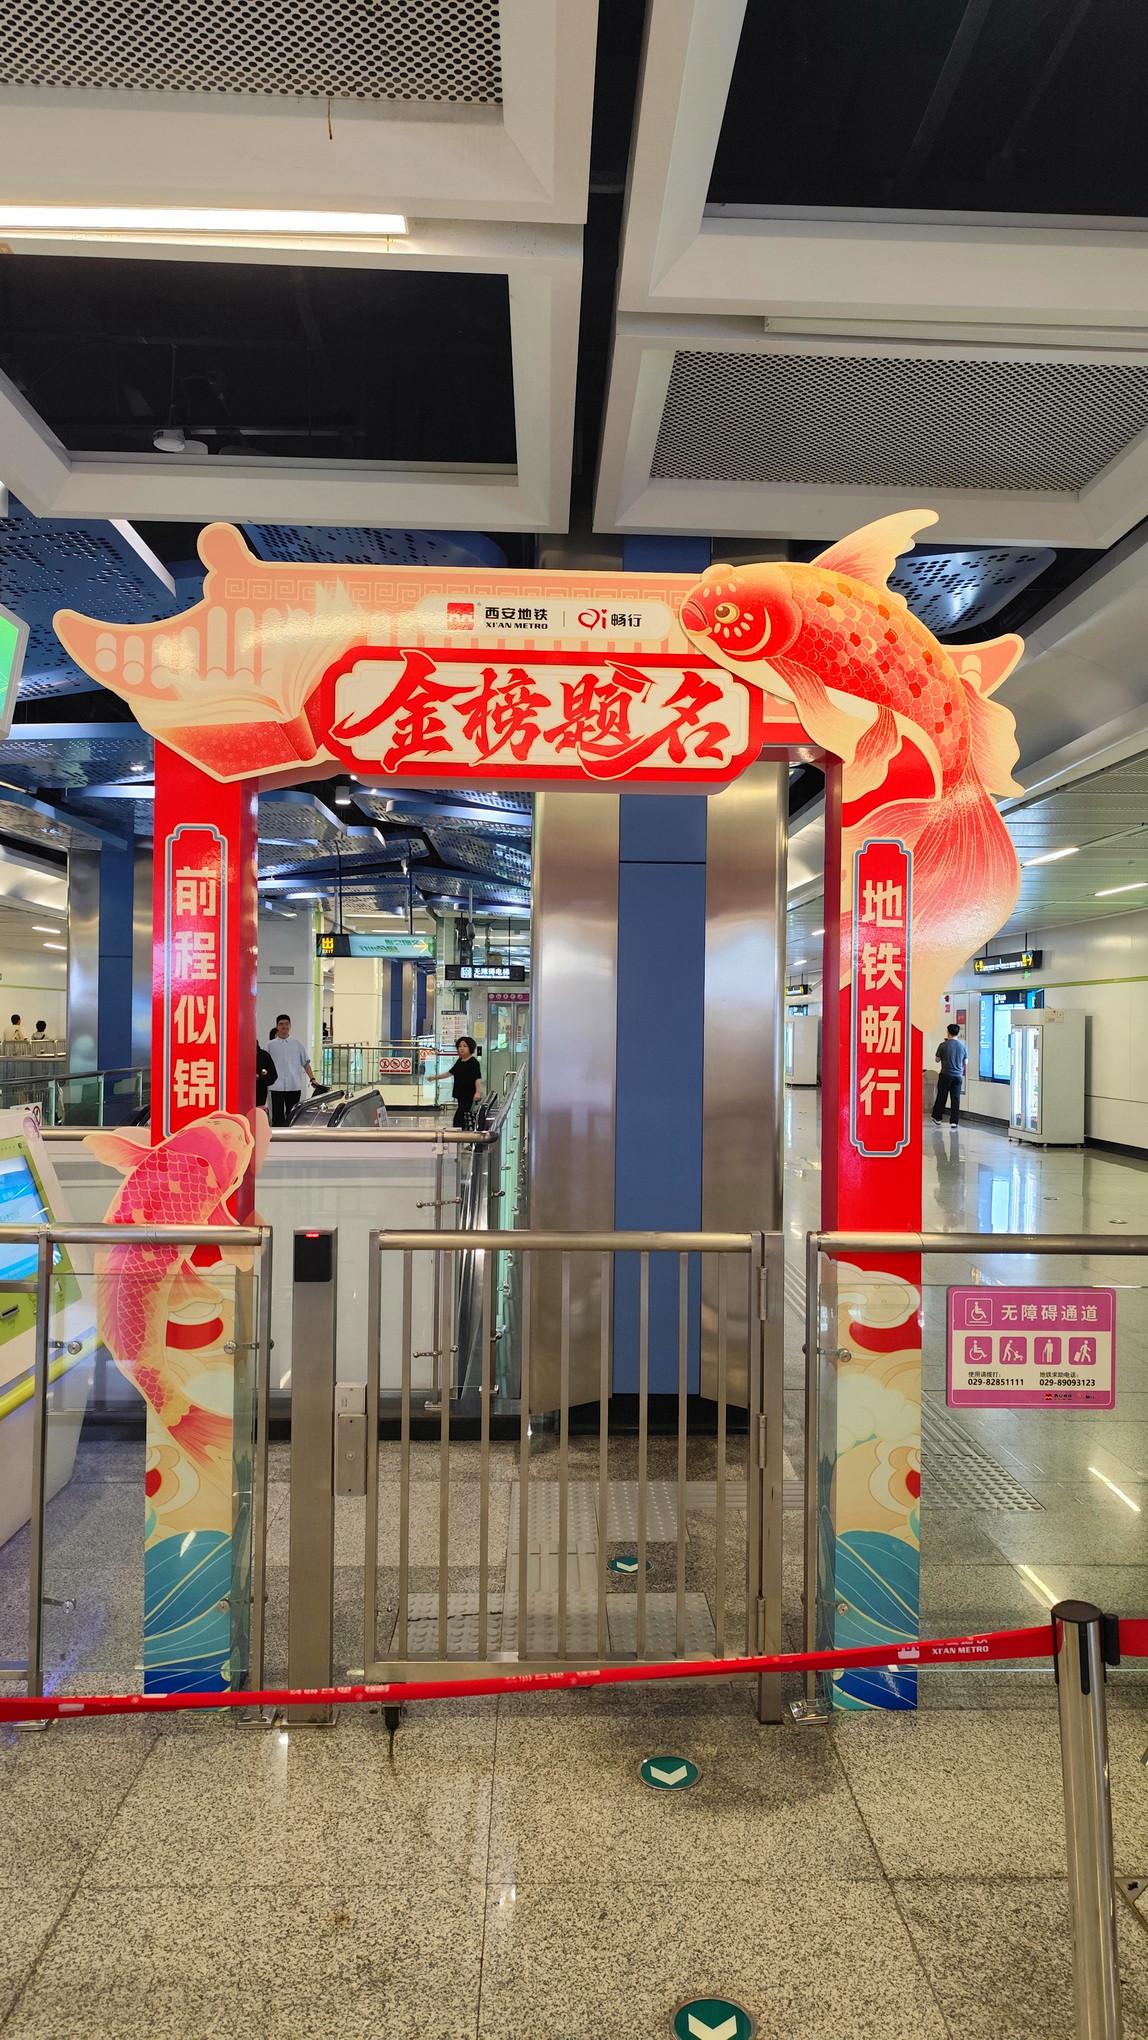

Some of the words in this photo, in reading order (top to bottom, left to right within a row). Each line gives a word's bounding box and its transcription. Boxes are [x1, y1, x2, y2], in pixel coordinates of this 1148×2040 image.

[485, 607, 548, 620] 西安地铁
[611, 613, 642, 627] 畅行
[332, 651, 730, 779] 金榜题名
[173, 866, 217, 1108] 前程似锦
[860, 879, 903, 1116] 地铁畅行
[1001, 1304, 1098, 1322] 无障碍通道
[968, 1378, 1024, 1386] 029-82851111
[1039, 1378, 1096, 1387] 029-89093123
[958, 1645, 989, 1654] METRO
